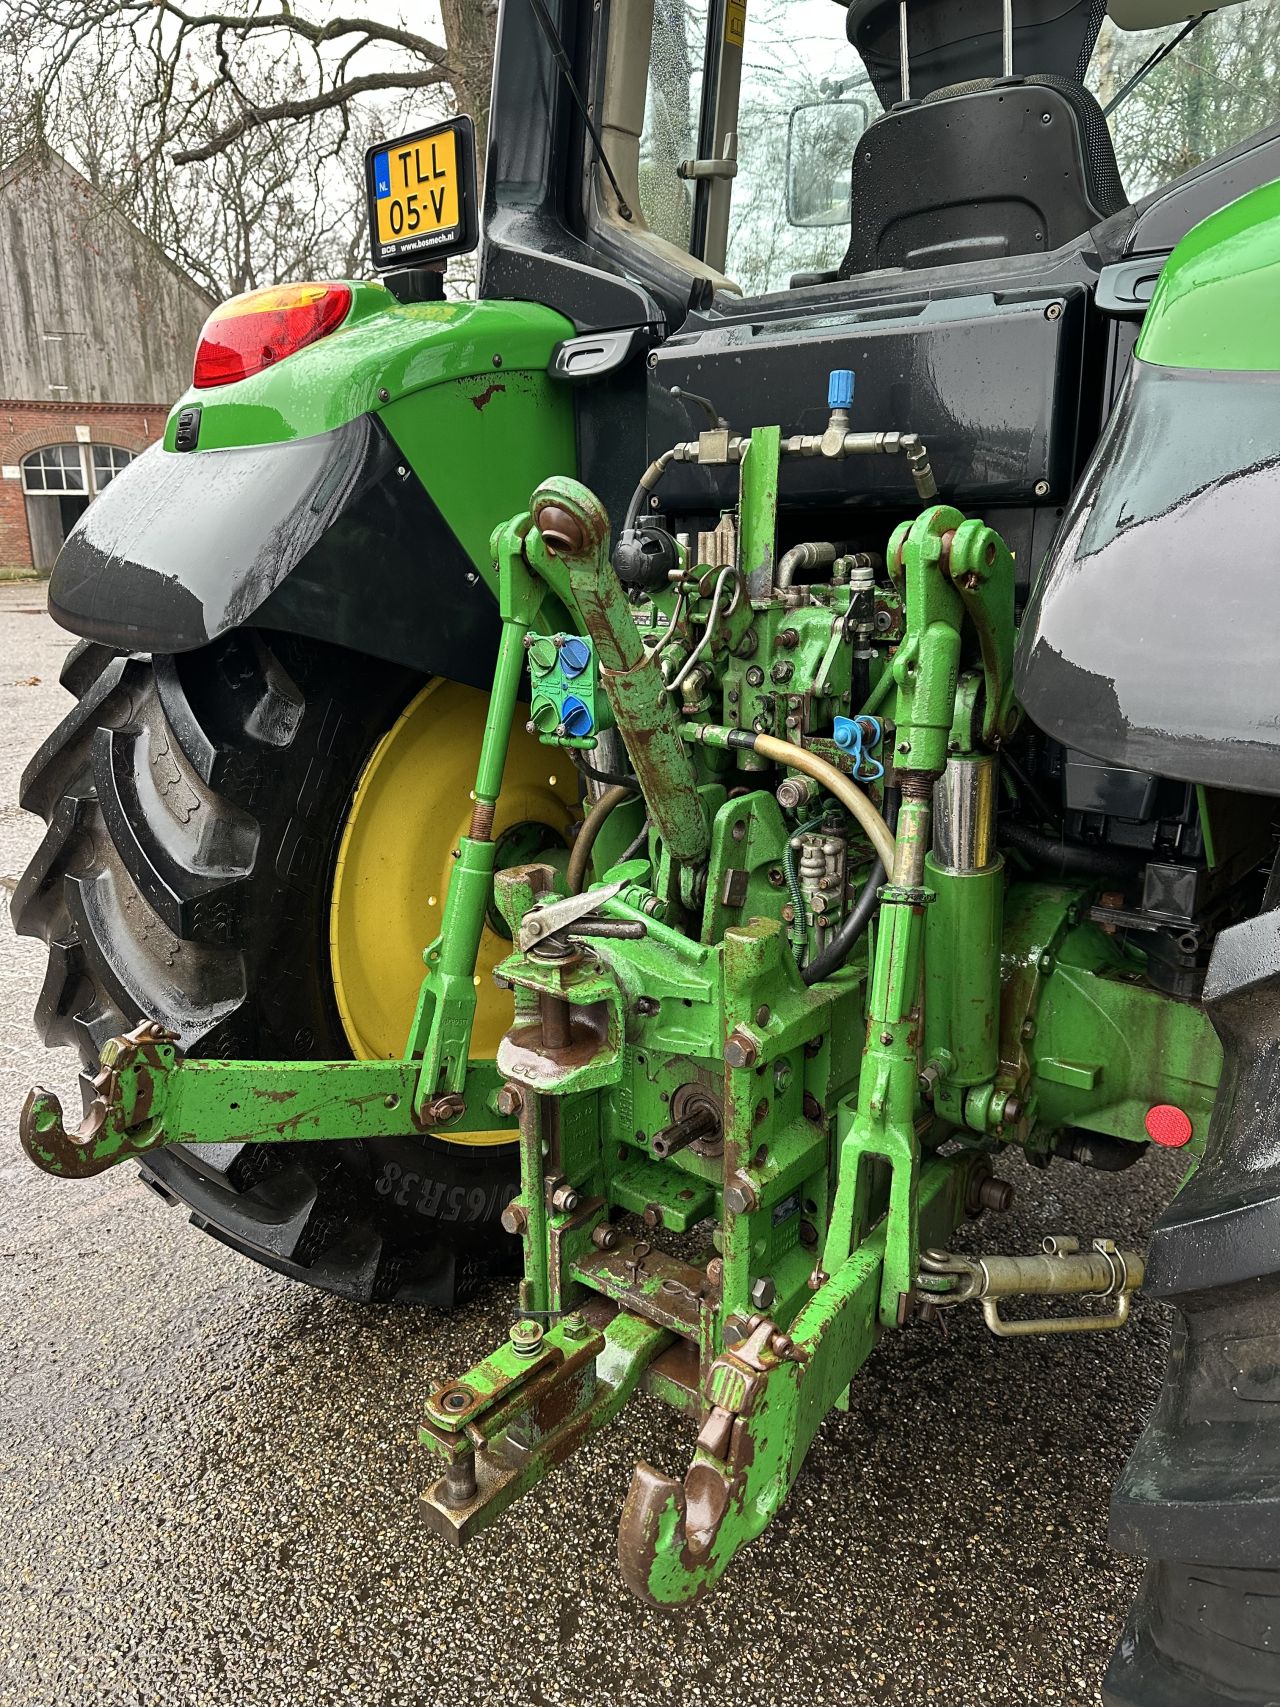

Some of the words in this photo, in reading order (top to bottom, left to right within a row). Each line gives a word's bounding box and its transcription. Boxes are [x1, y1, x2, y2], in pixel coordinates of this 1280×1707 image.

[399, 143, 446, 187] TLL
[379, 182, 388, 192] NL
[381, 244, 397, 255] BOS
[401, 232, 454, 252] www.bosmech.nl
